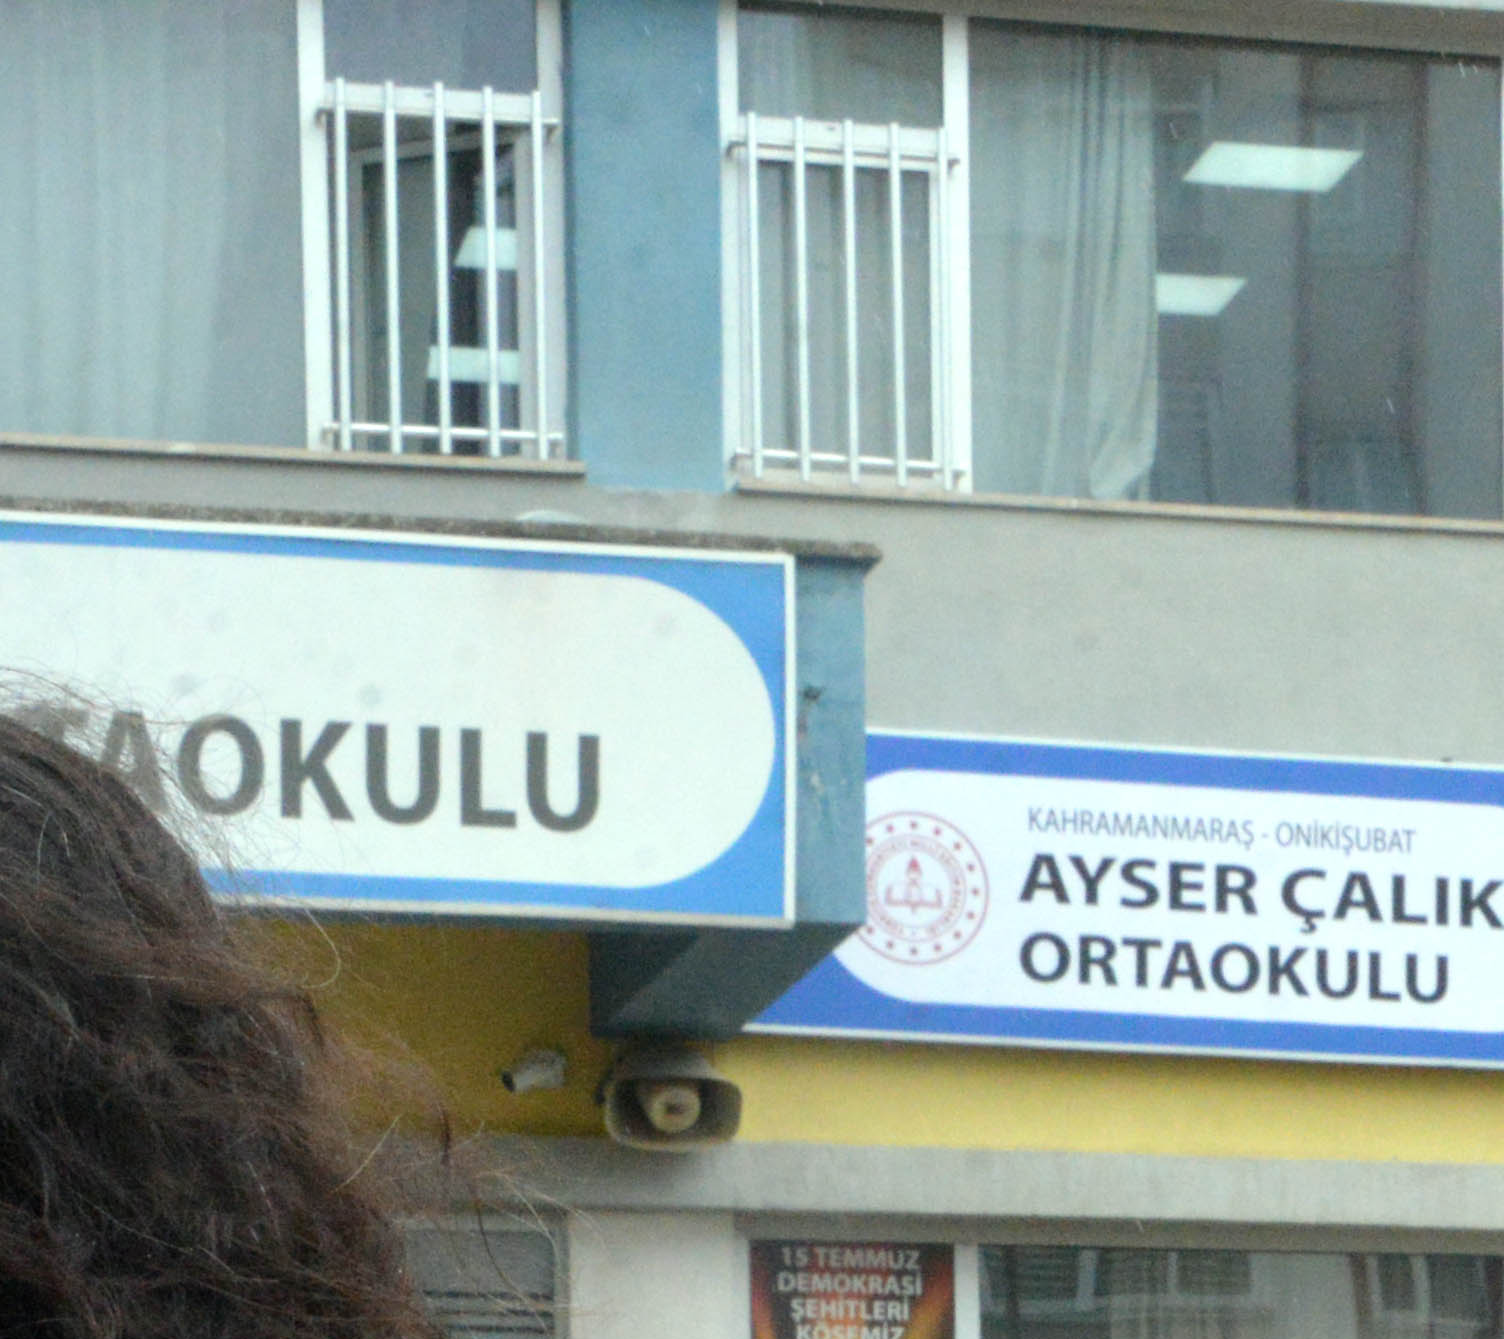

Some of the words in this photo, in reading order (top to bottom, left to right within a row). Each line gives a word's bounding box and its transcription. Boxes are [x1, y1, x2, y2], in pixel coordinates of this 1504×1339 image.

[1027, 806, 1255, 851] KAHRAMANMARAŞ
[1275, 819, 1416, 856] ONİKİŞUBAT
[1018, 852, 1258, 916] AYSER
[1018, 930, 1449, 1005] ORTAOKULU
[781, 1246, 809, 1267] 15
[813, 1246, 921, 1270] TEMMUZ
[776, 1268, 923, 1297] DEMOKRASİ
[790, 1296, 910, 1322] ŞEHİTLERİ
